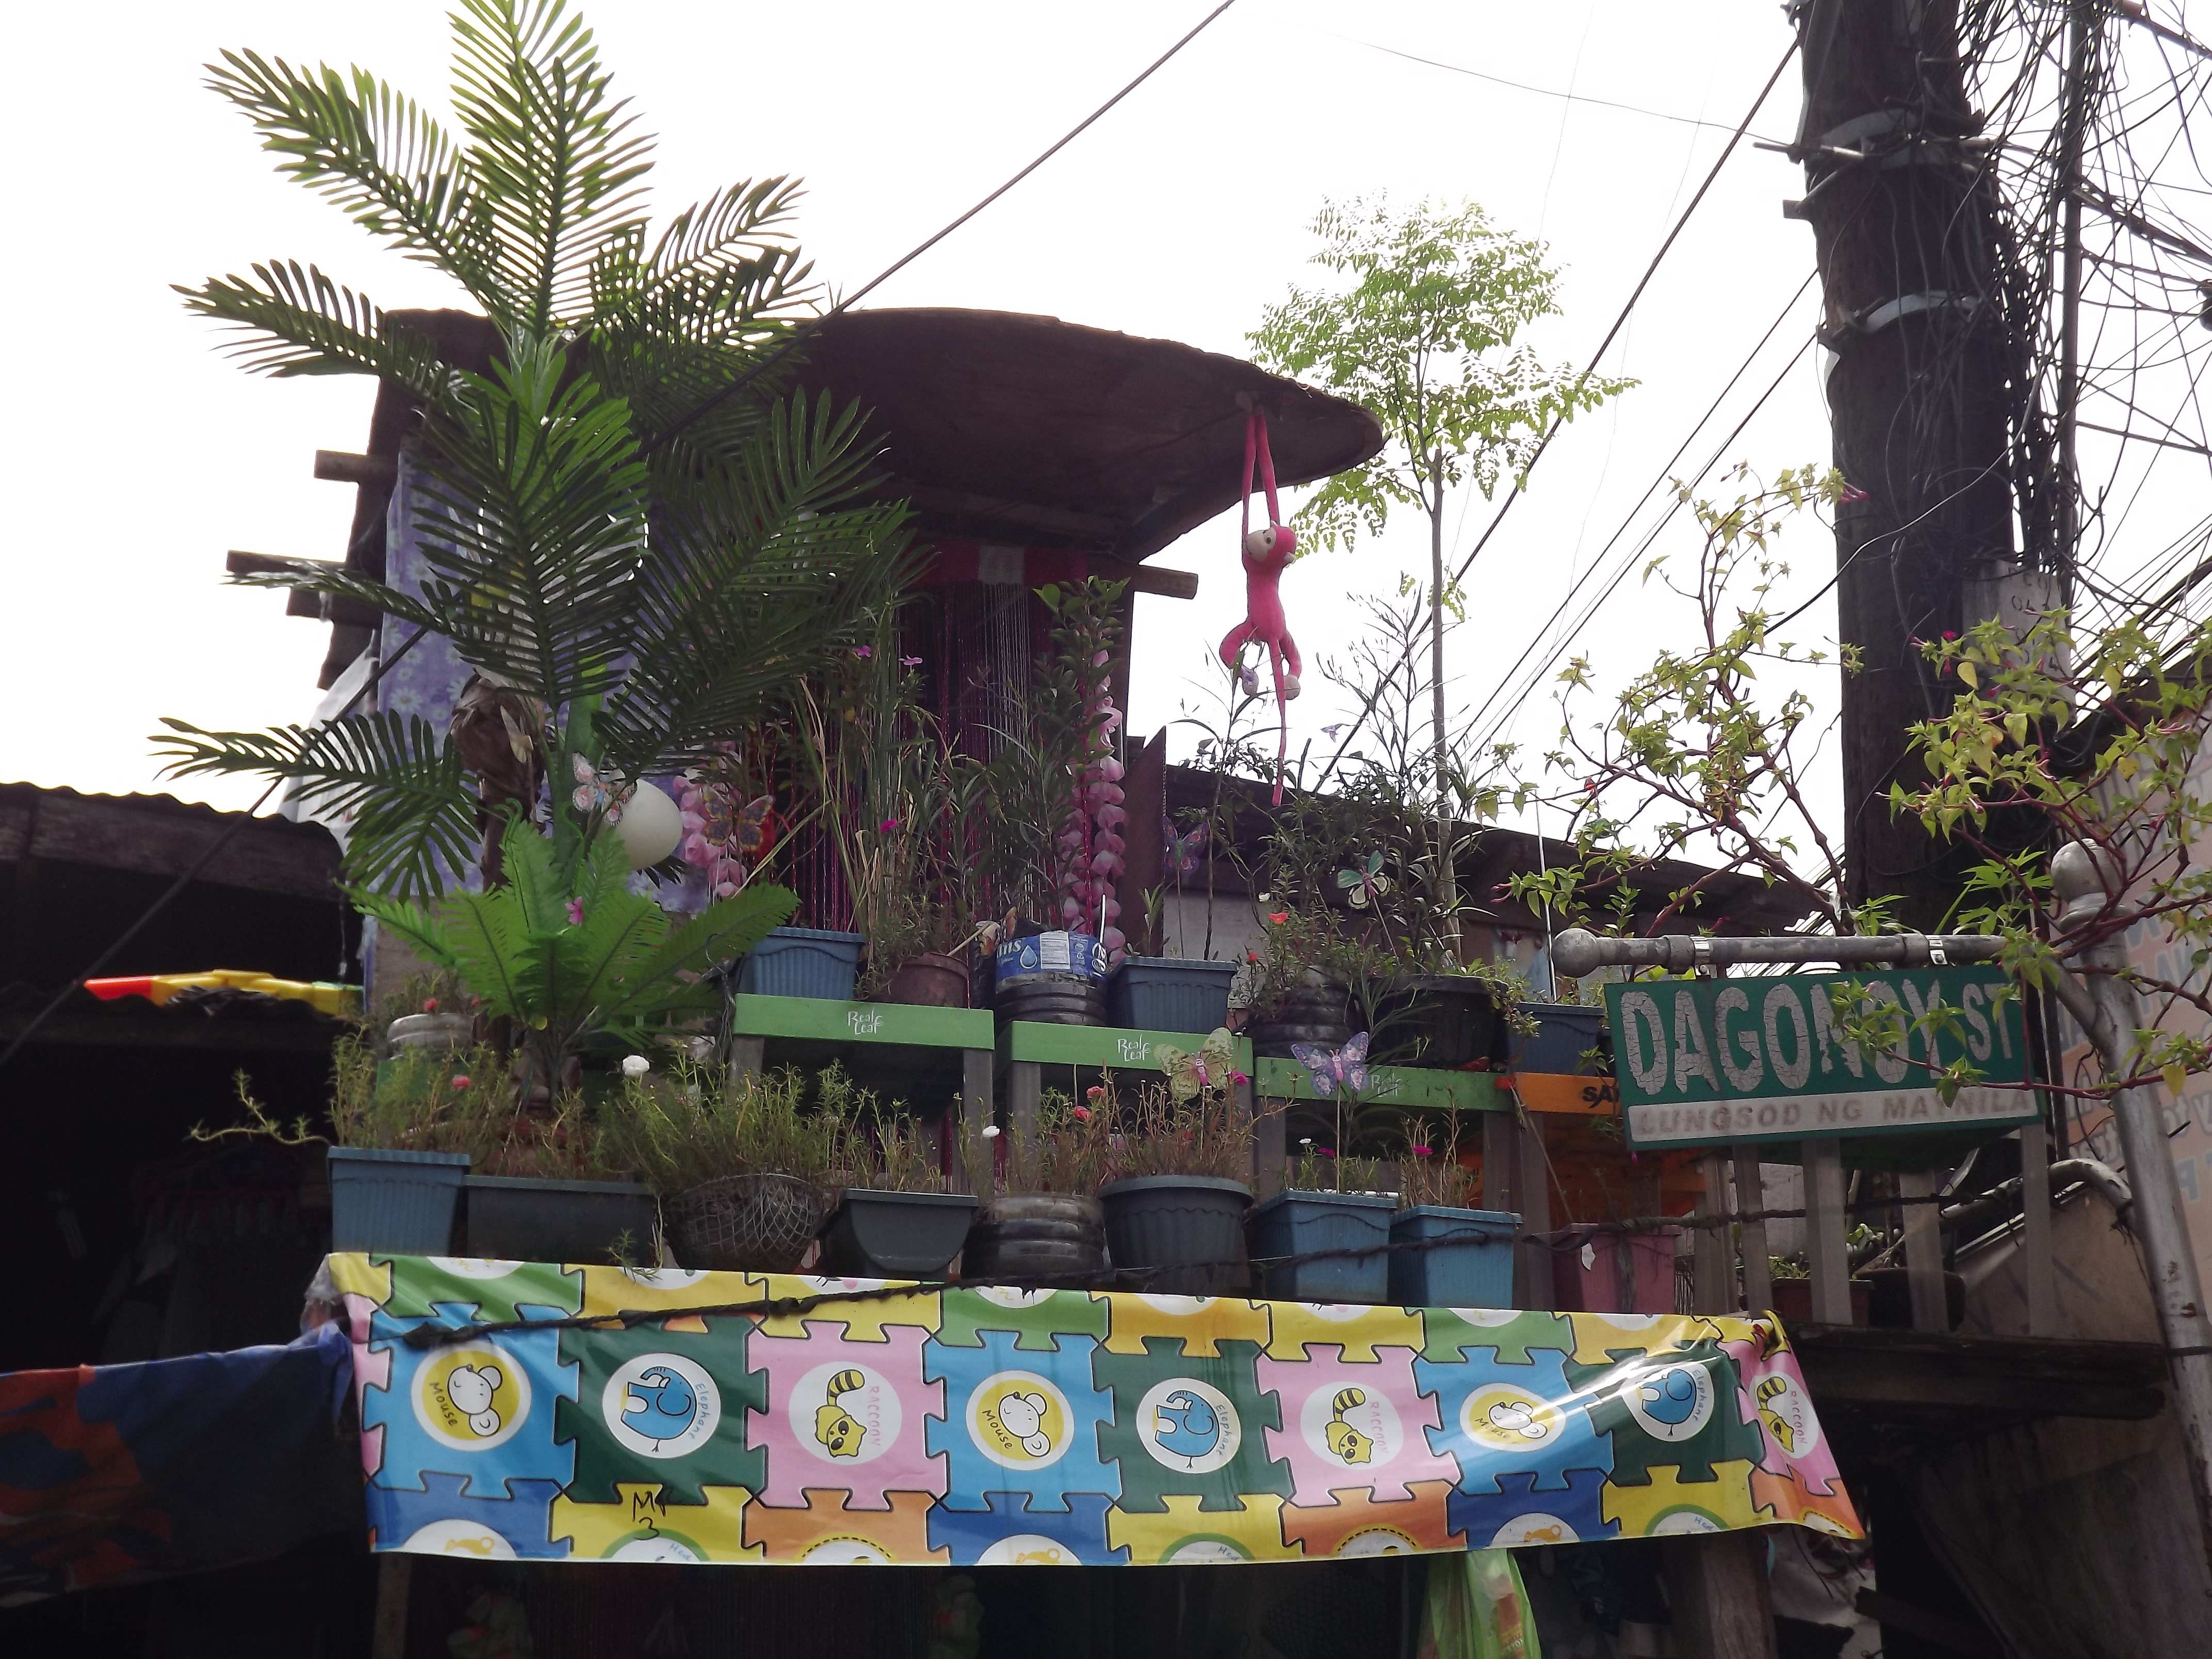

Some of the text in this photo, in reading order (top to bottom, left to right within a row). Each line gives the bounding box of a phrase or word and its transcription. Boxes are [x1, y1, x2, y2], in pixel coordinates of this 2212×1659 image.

[848, 1007, 875, 1027] Real
[854, 1015, 883, 1035] Leaf
[1621, 979, 1943, 1095] DAGONOY
[1962, 983, 2022, 1062] ST
[1117, 1033, 1142, 1053] Real
[1124, 1043, 1150, 1062] Leaf
[1637, 1103, 1802, 1134] LUNGSOD
[1817, 1099, 1862, 1123] NG
[1883, 1089, 2029, 1120] MAYNILA
[429, 1382, 458, 1426] Mouse
[689, 1383, 710, 1438] Elephant
[867, 1386, 880, 1446] RACCOON
[1693, 1370, 1707, 1421] Elephant
[1791, 1390, 1808, 1443] RACCOON
[982, 1409, 1013, 1449] Mouse
[1215, 1404, 1232, 1455] Elephant
[1370, 1402, 1389, 1453] RACCOON
[1474, 1418, 1510, 1439] Mouse
